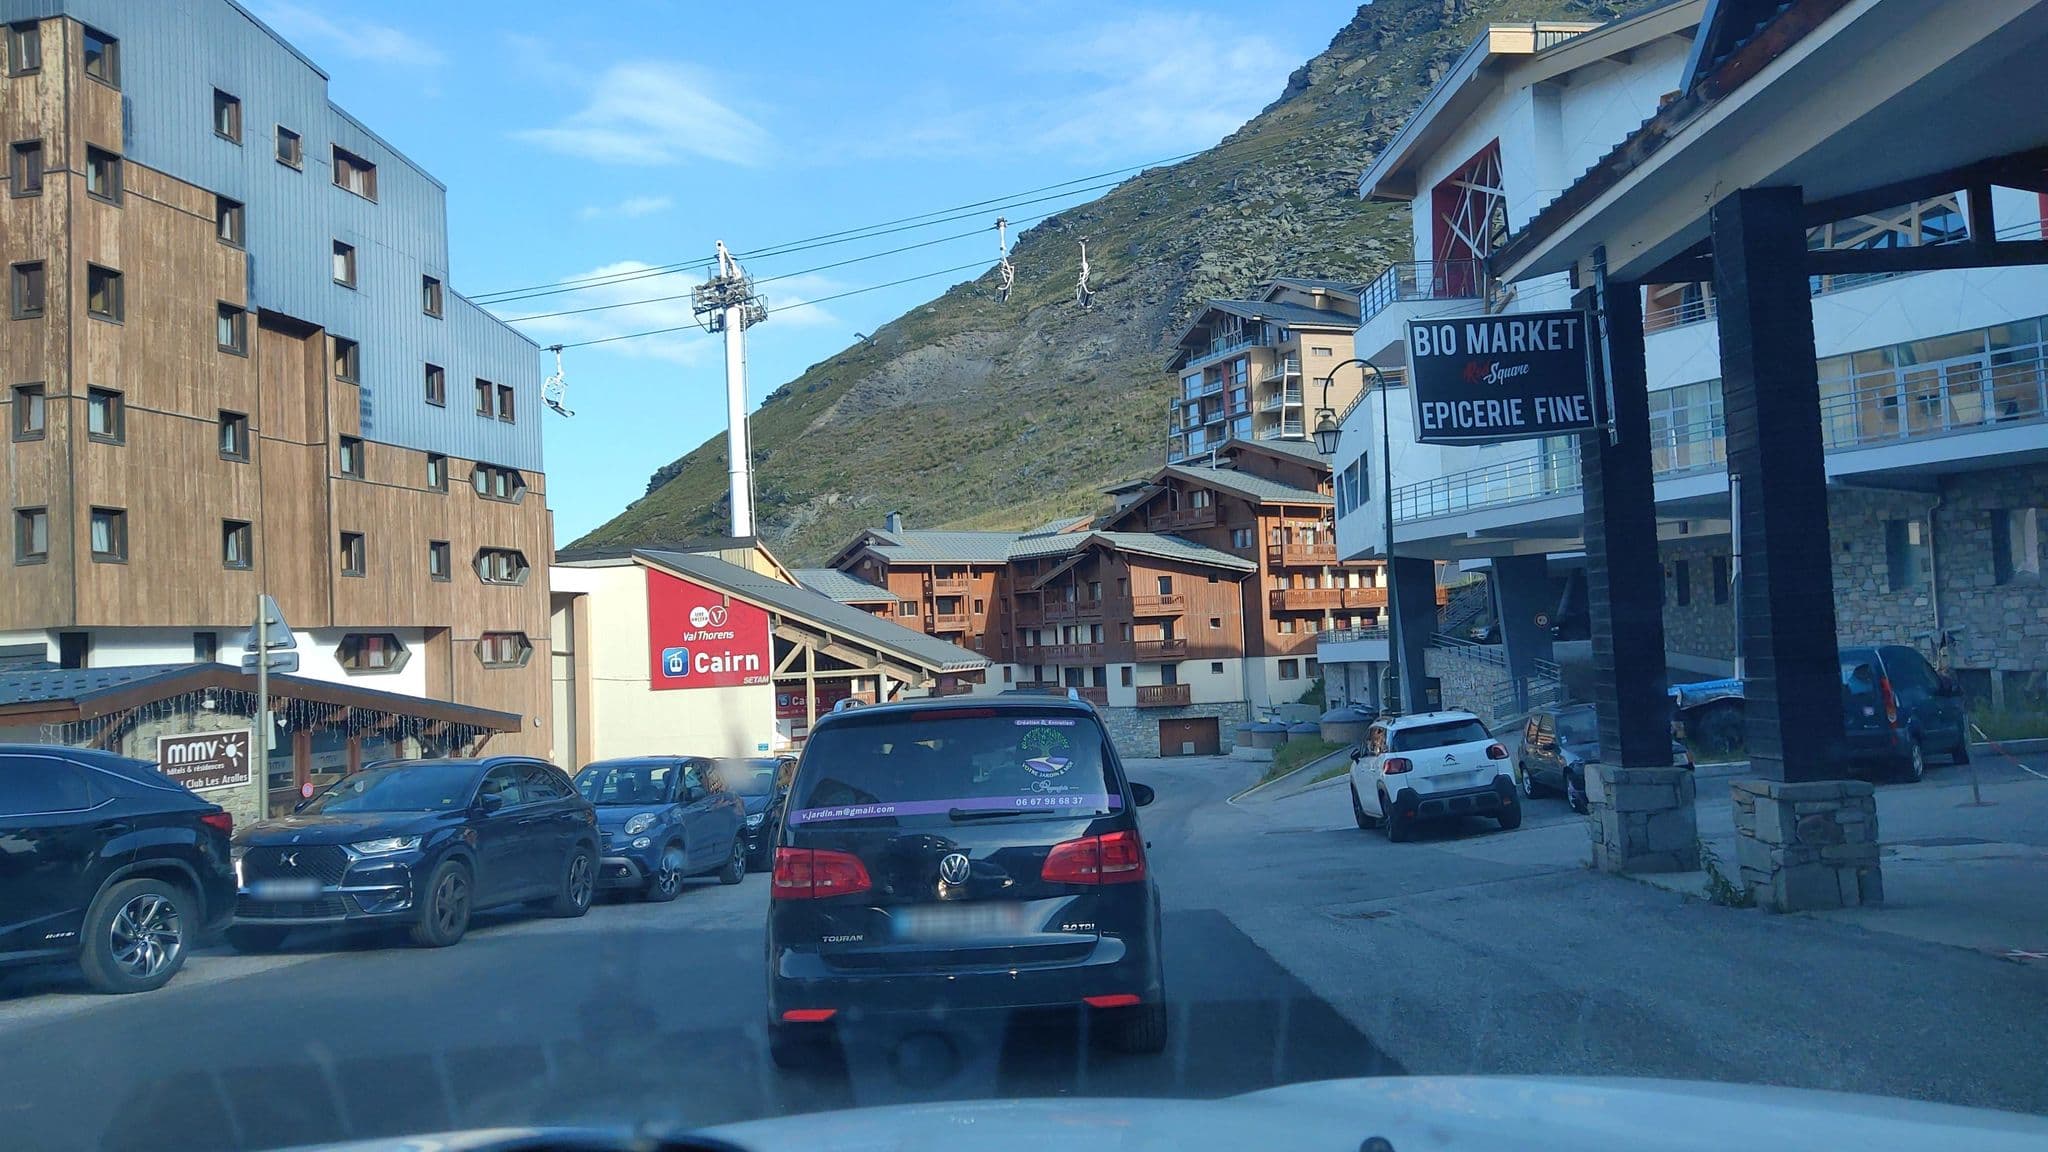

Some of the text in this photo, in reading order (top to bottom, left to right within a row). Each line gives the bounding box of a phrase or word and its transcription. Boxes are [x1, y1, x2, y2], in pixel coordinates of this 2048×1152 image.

[1413, 318, 1578, 357] BIO MARKET
[1483, 361, 1529, 384] Square
[1421, 395, 1590, 430] EPICERIE FINE
[683, 630, 735, 641] Val Thorens
[694, 650, 759, 674] Cairn
[743, 675, 769, 684] SETAM
[792, 696, 821, 706] Can
[167, 740, 219, 764] mmv
[166, 763, 225, 776] hôtels & résidences
[186, 778, 203, 788] Club
[205, 777, 219, 786] Les
[222, 773, 248, 784] Arolles
[1015, 798, 1028, 806] 06
[1030, 798, 1042, 806] 67
[1044, 797, 1056, 805] 98
[1058, 797, 1070, 805] 68
[802, 806, 895, 820] v.jardin.m@gmail.com
[822, 934, 864, 942] TOURAN
